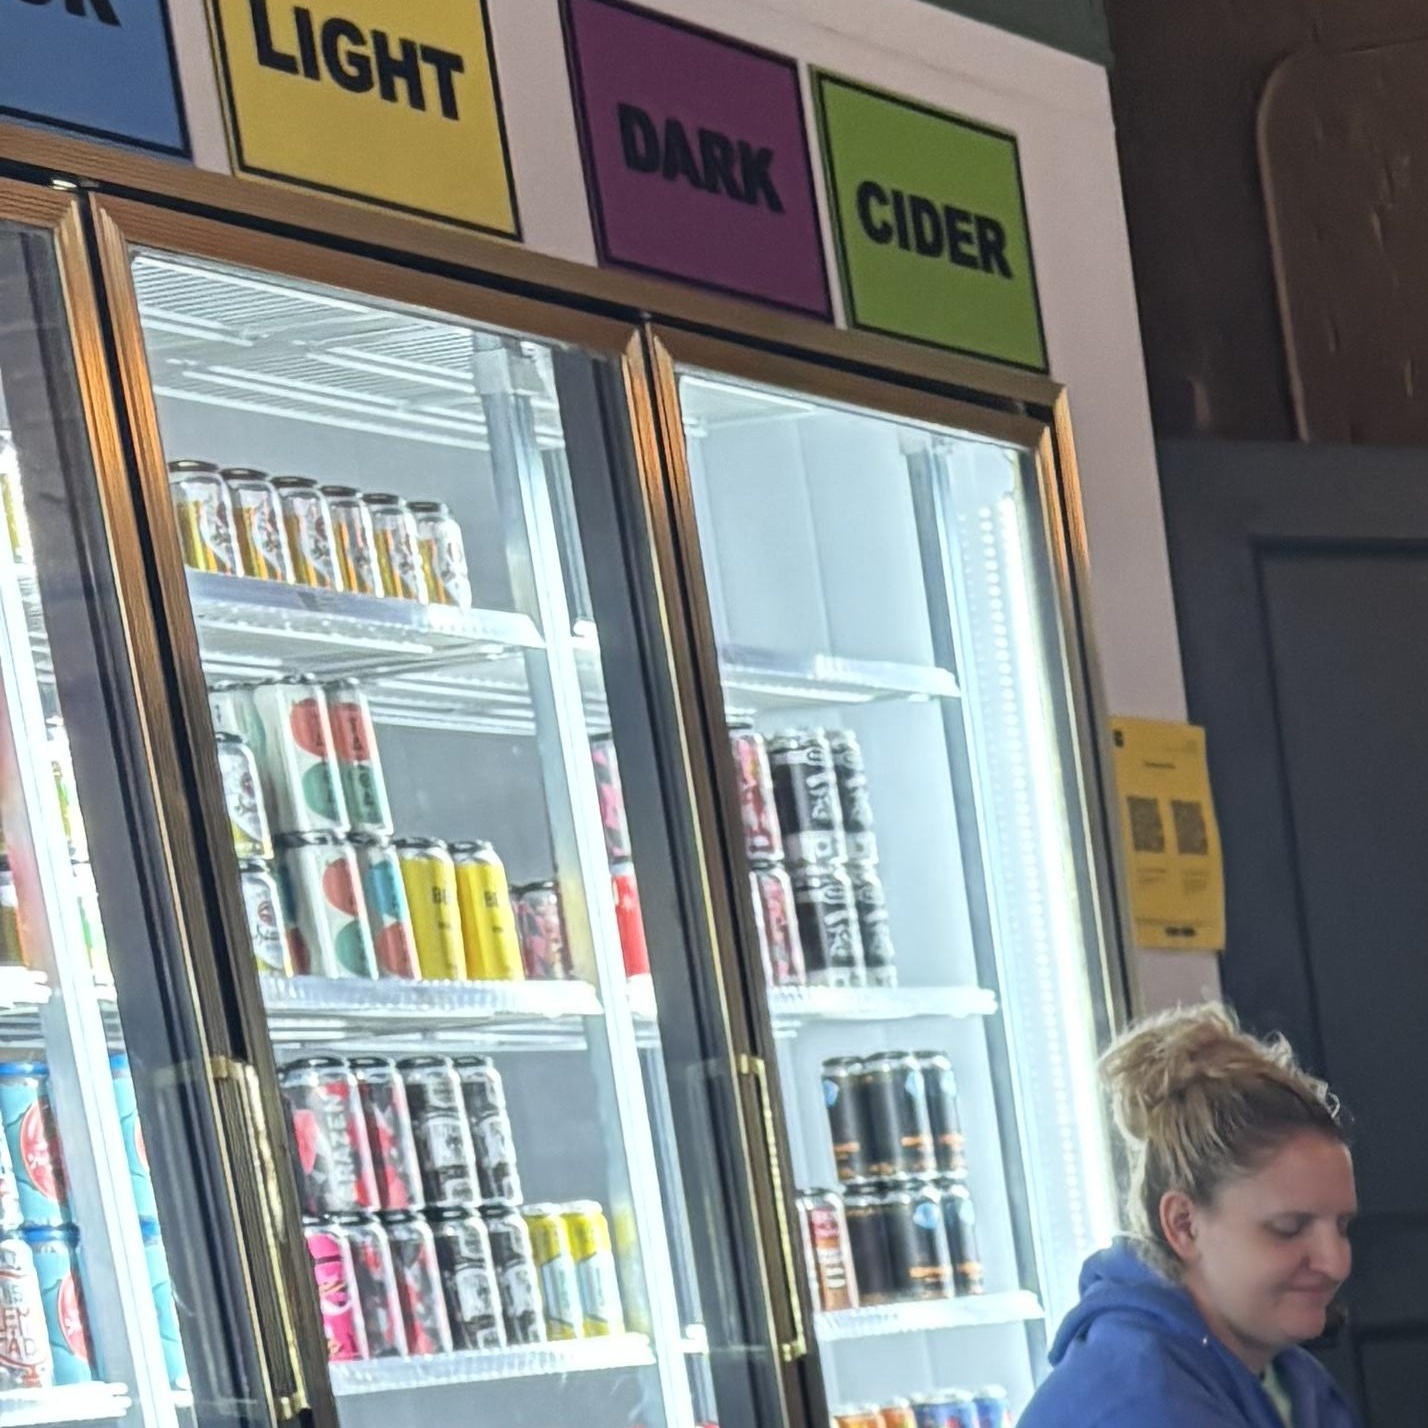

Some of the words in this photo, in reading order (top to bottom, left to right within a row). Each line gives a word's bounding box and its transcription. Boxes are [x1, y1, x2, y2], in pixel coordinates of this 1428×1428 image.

[250, 0, 465, 121] LIGHT
[617, 101, 785, 214] DARK
[856, 180, 1013, 280] CIDER
